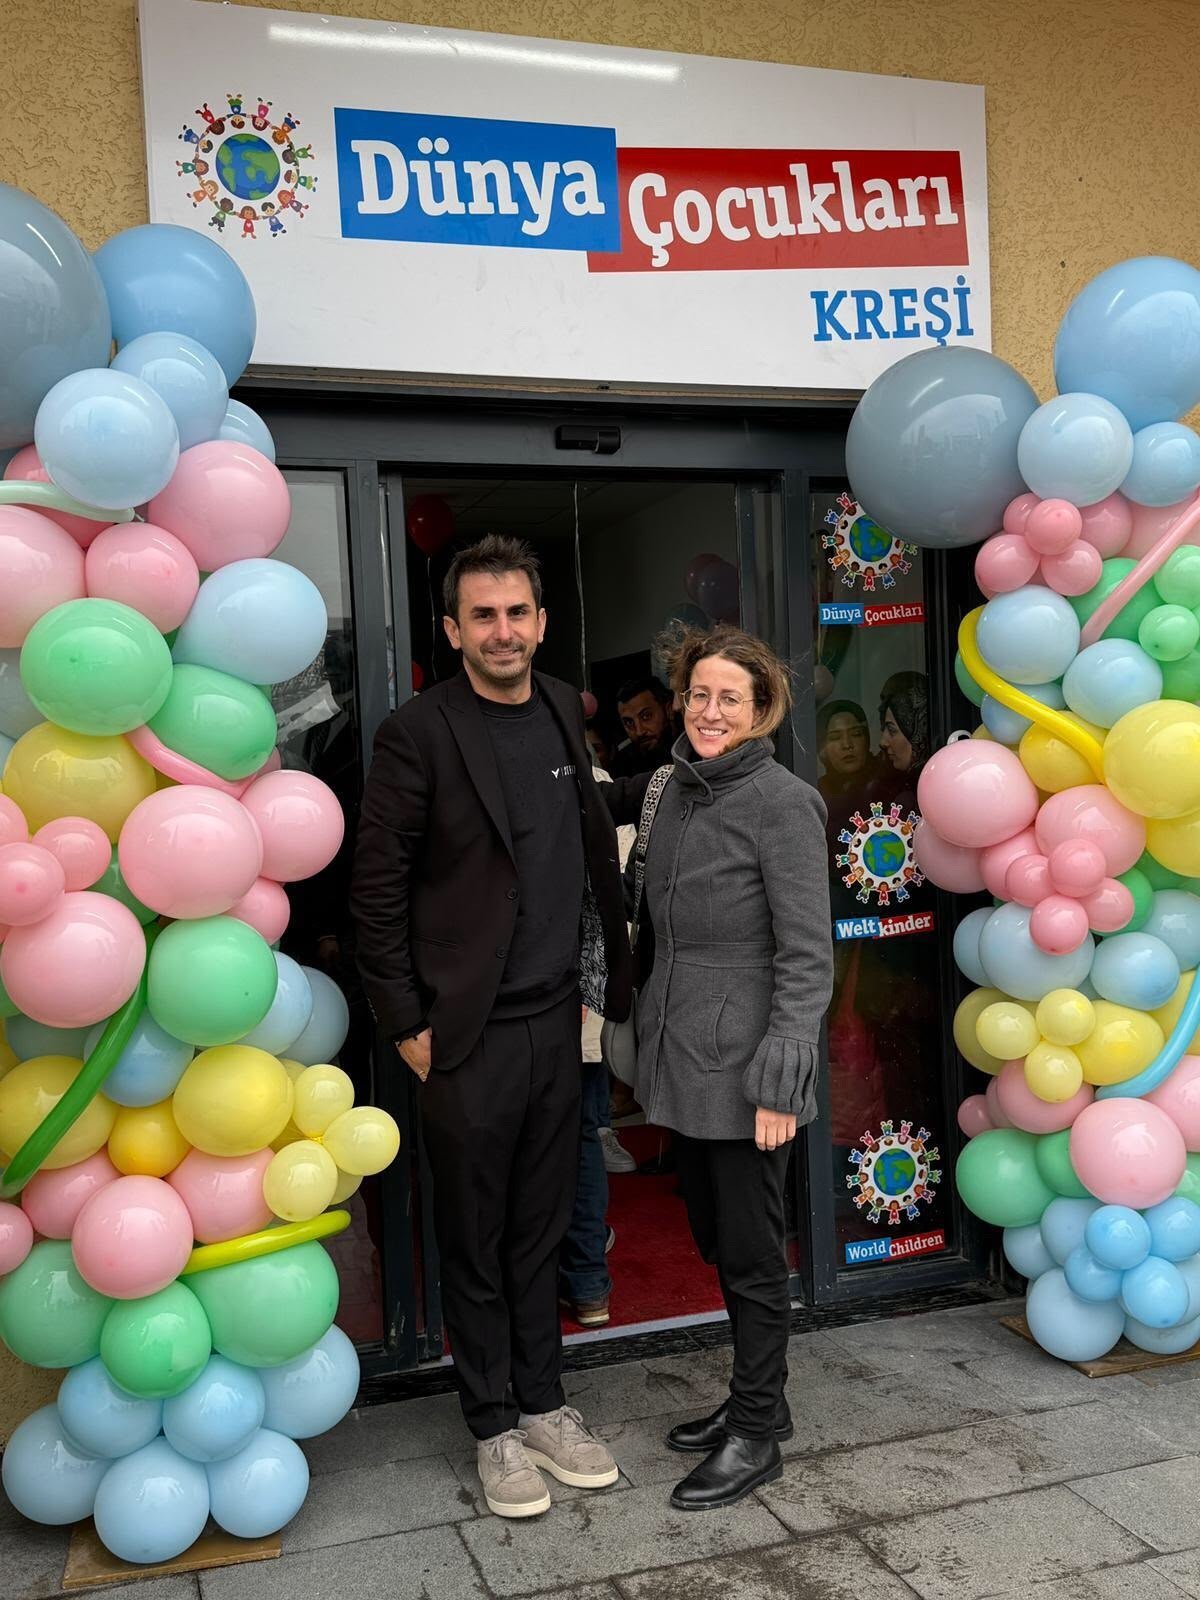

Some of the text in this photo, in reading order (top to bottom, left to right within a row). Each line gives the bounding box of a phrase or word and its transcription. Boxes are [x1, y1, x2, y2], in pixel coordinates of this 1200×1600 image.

[350, 137, 959, 268] Dünya Çocukları
[810, 274, 975, 347] KREŞİ
[822, 605, 924, 626] Dünya Çocukları
[848, 1234, 943, 1260] World Children
